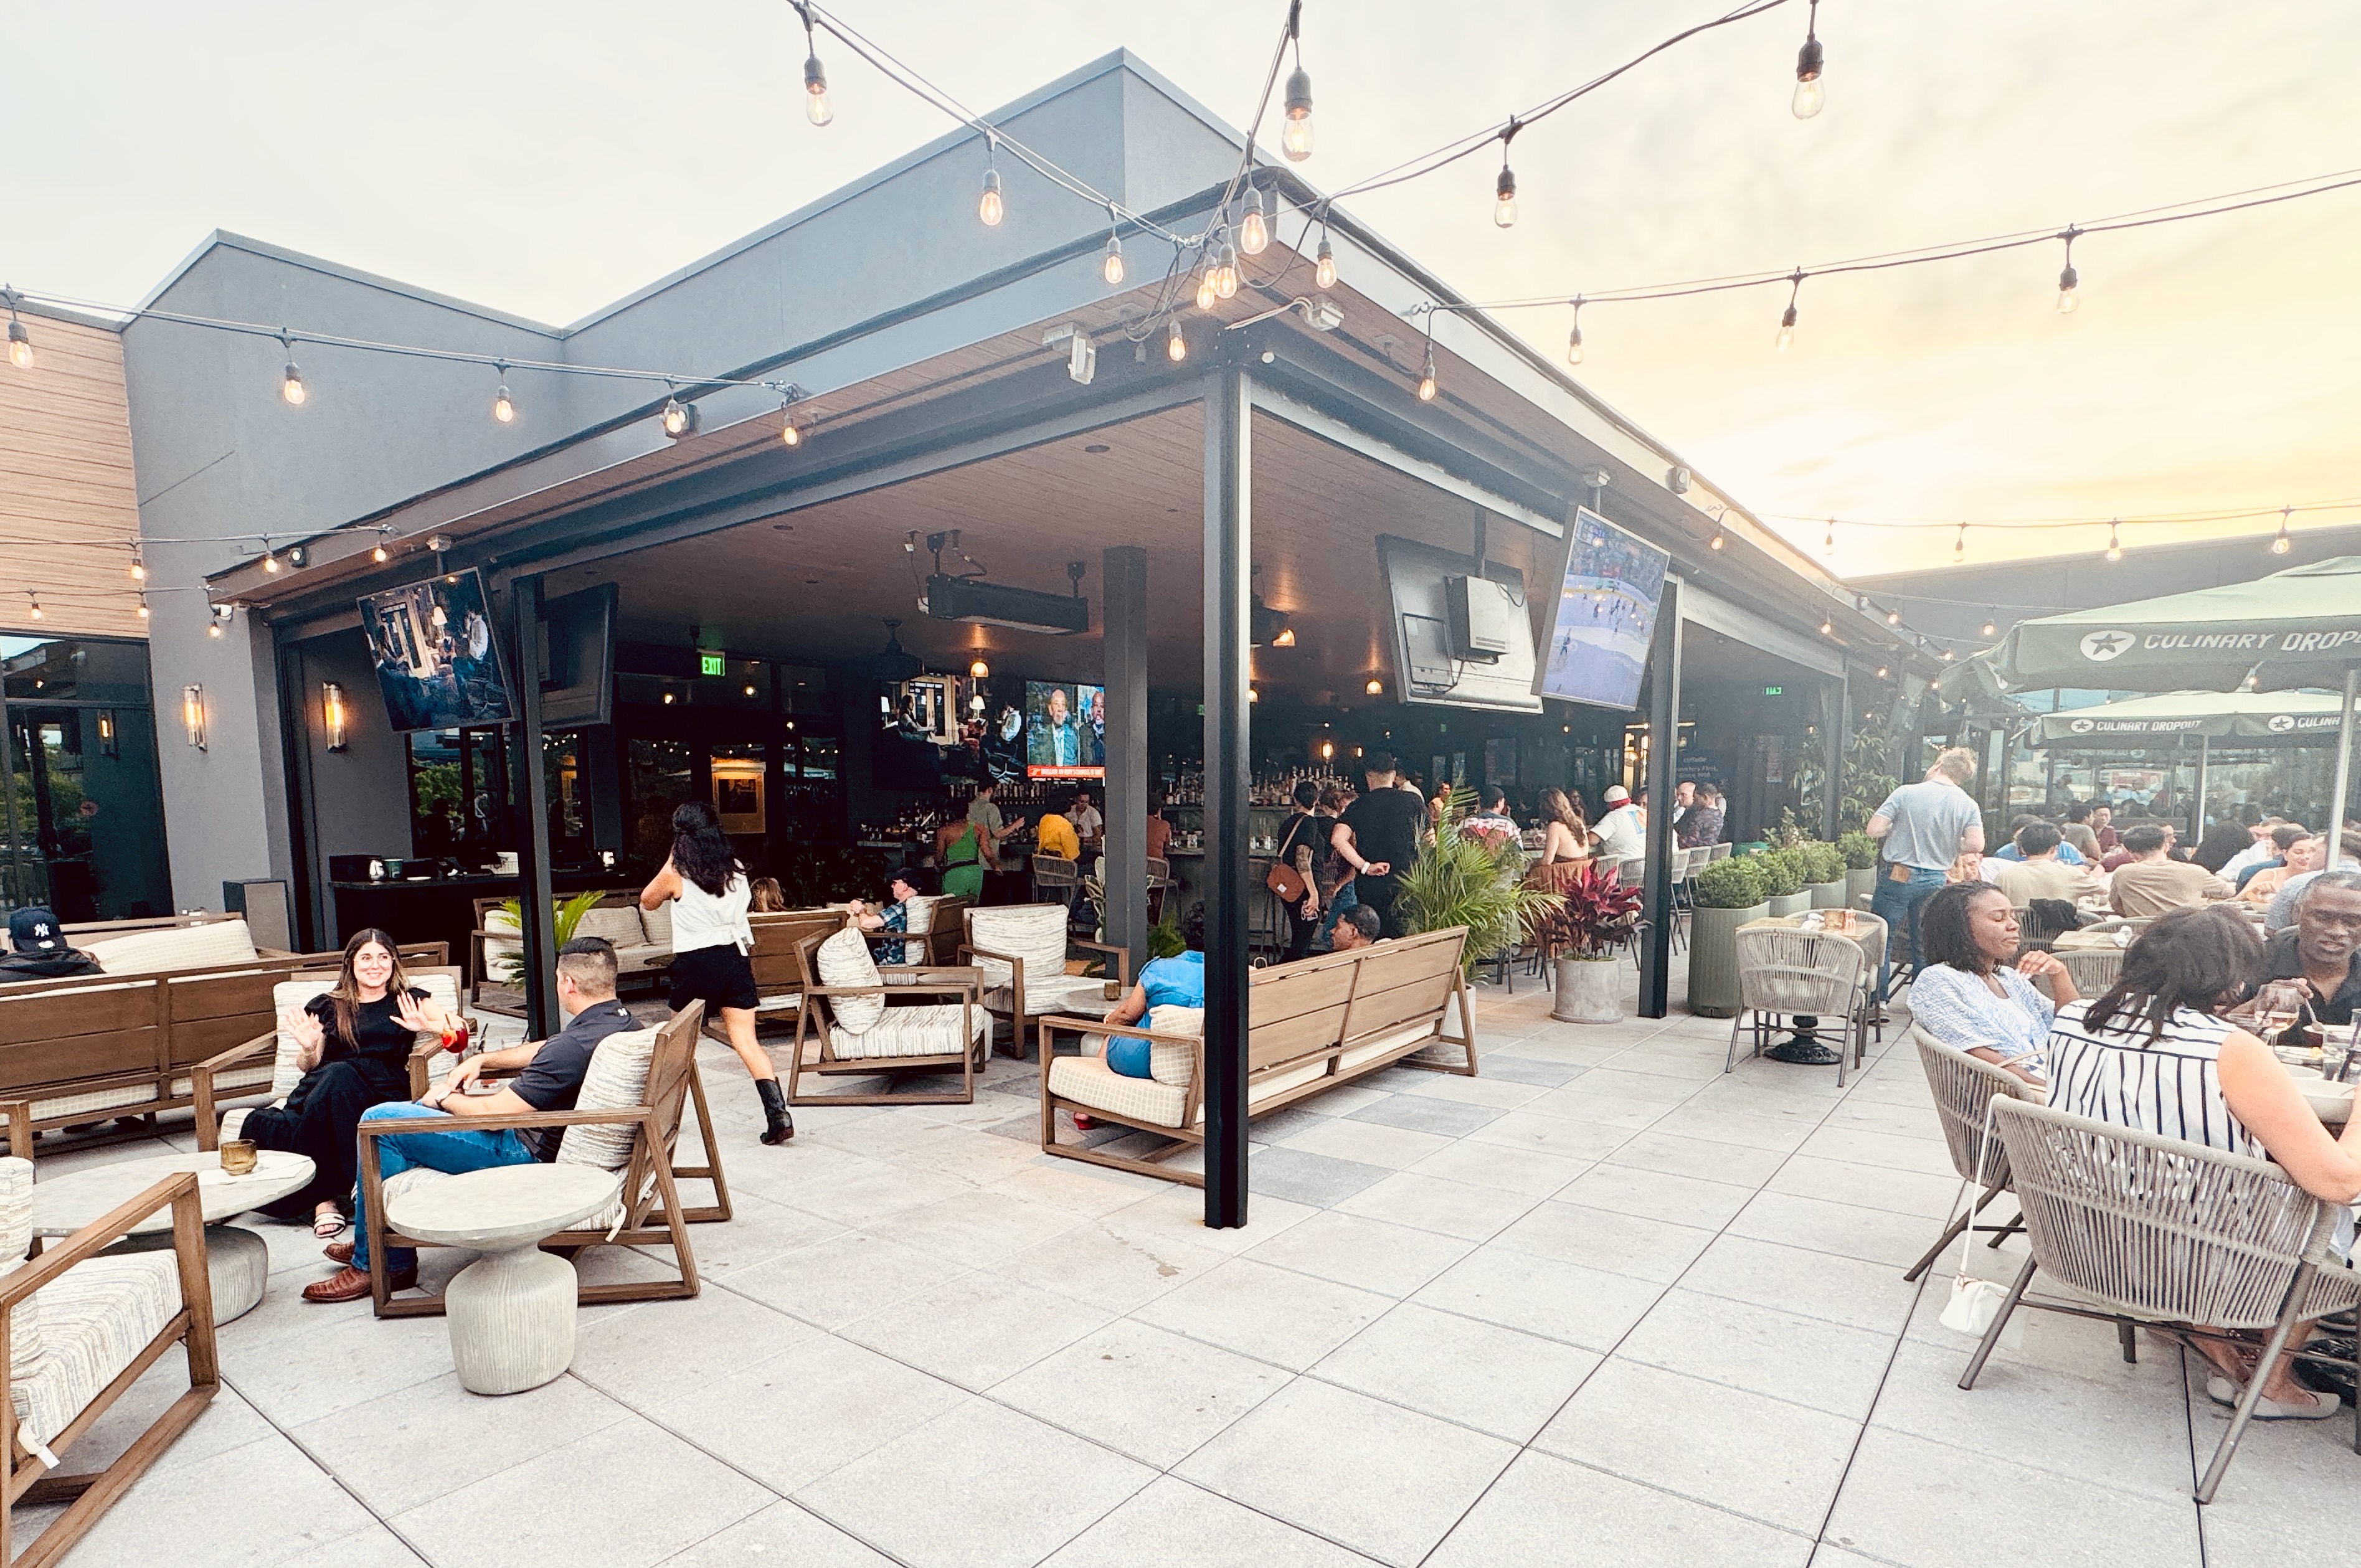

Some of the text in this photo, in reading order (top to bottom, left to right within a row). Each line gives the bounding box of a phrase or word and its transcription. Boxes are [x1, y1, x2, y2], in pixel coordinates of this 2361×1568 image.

[2144, 633, 2276, 649] CULINARY
[702, 657, 722, 675] EXIT
[2096, 720, 2203, 731] CULINARY DROPOUT
[2297, 716, 2341, 728] CULINA
